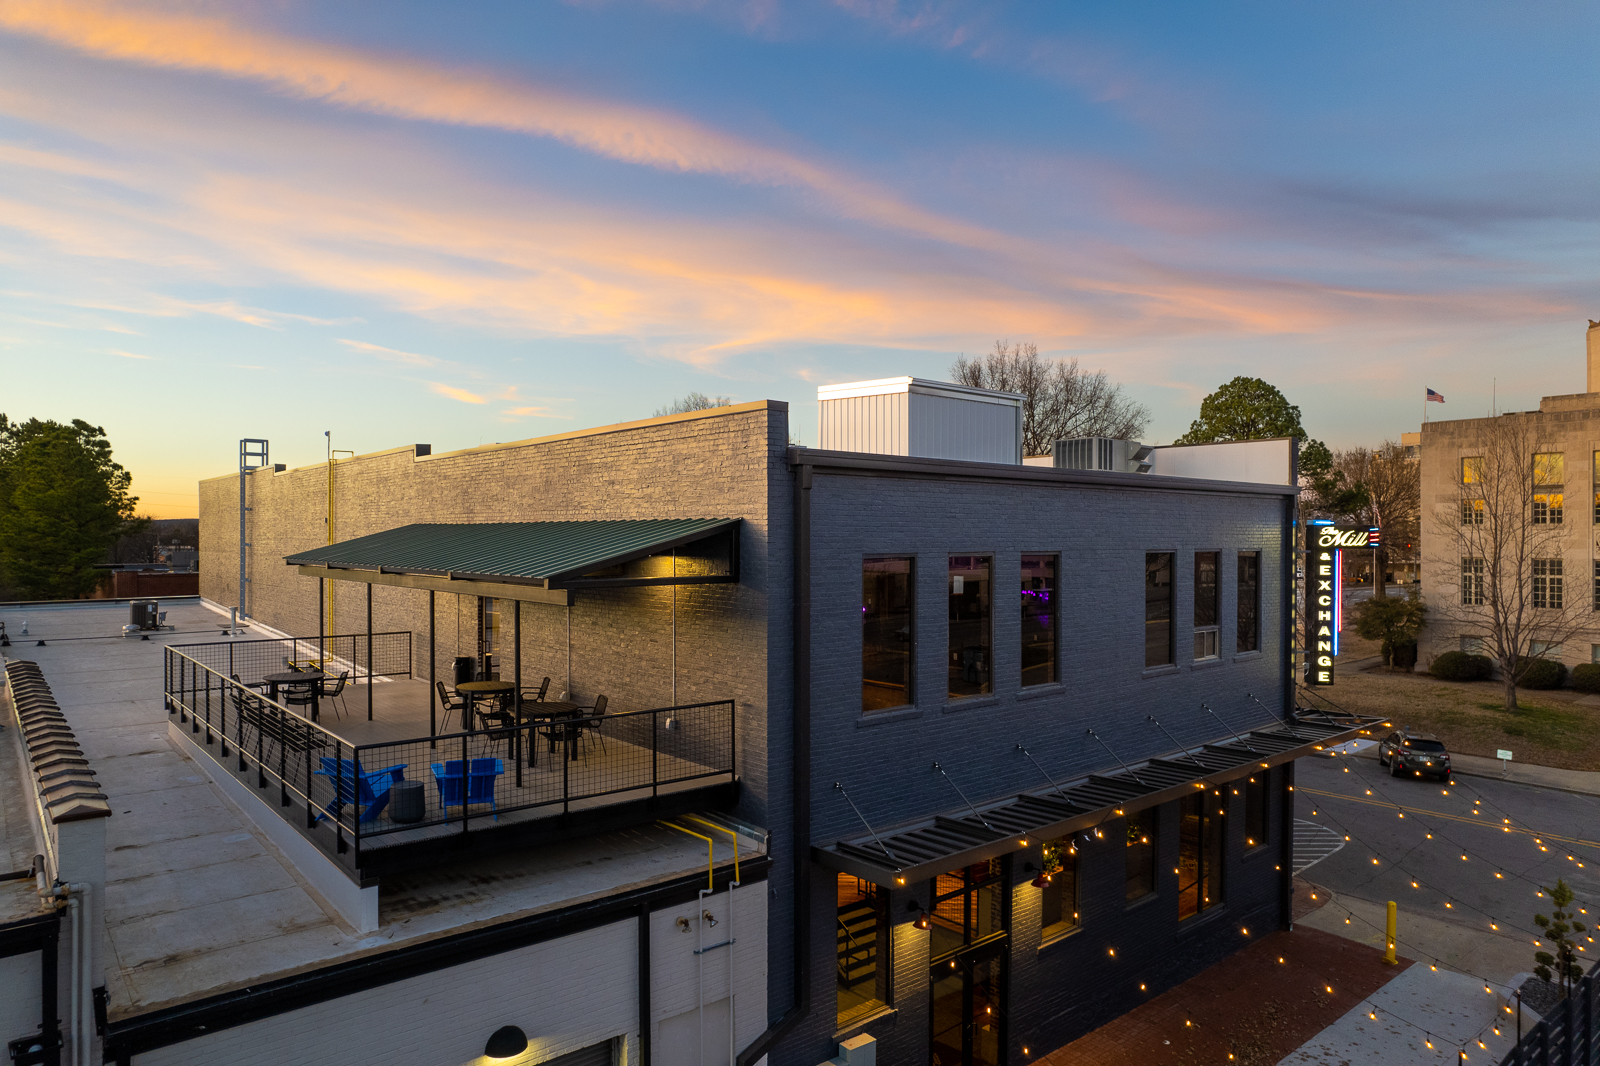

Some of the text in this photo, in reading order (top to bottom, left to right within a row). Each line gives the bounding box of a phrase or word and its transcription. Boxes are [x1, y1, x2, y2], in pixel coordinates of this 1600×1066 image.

[1319, 530, 1368, 547] Mill
[1320, 526, 1339, 535] The
[1317, 552, 1332, 682] & EXCHANGE
